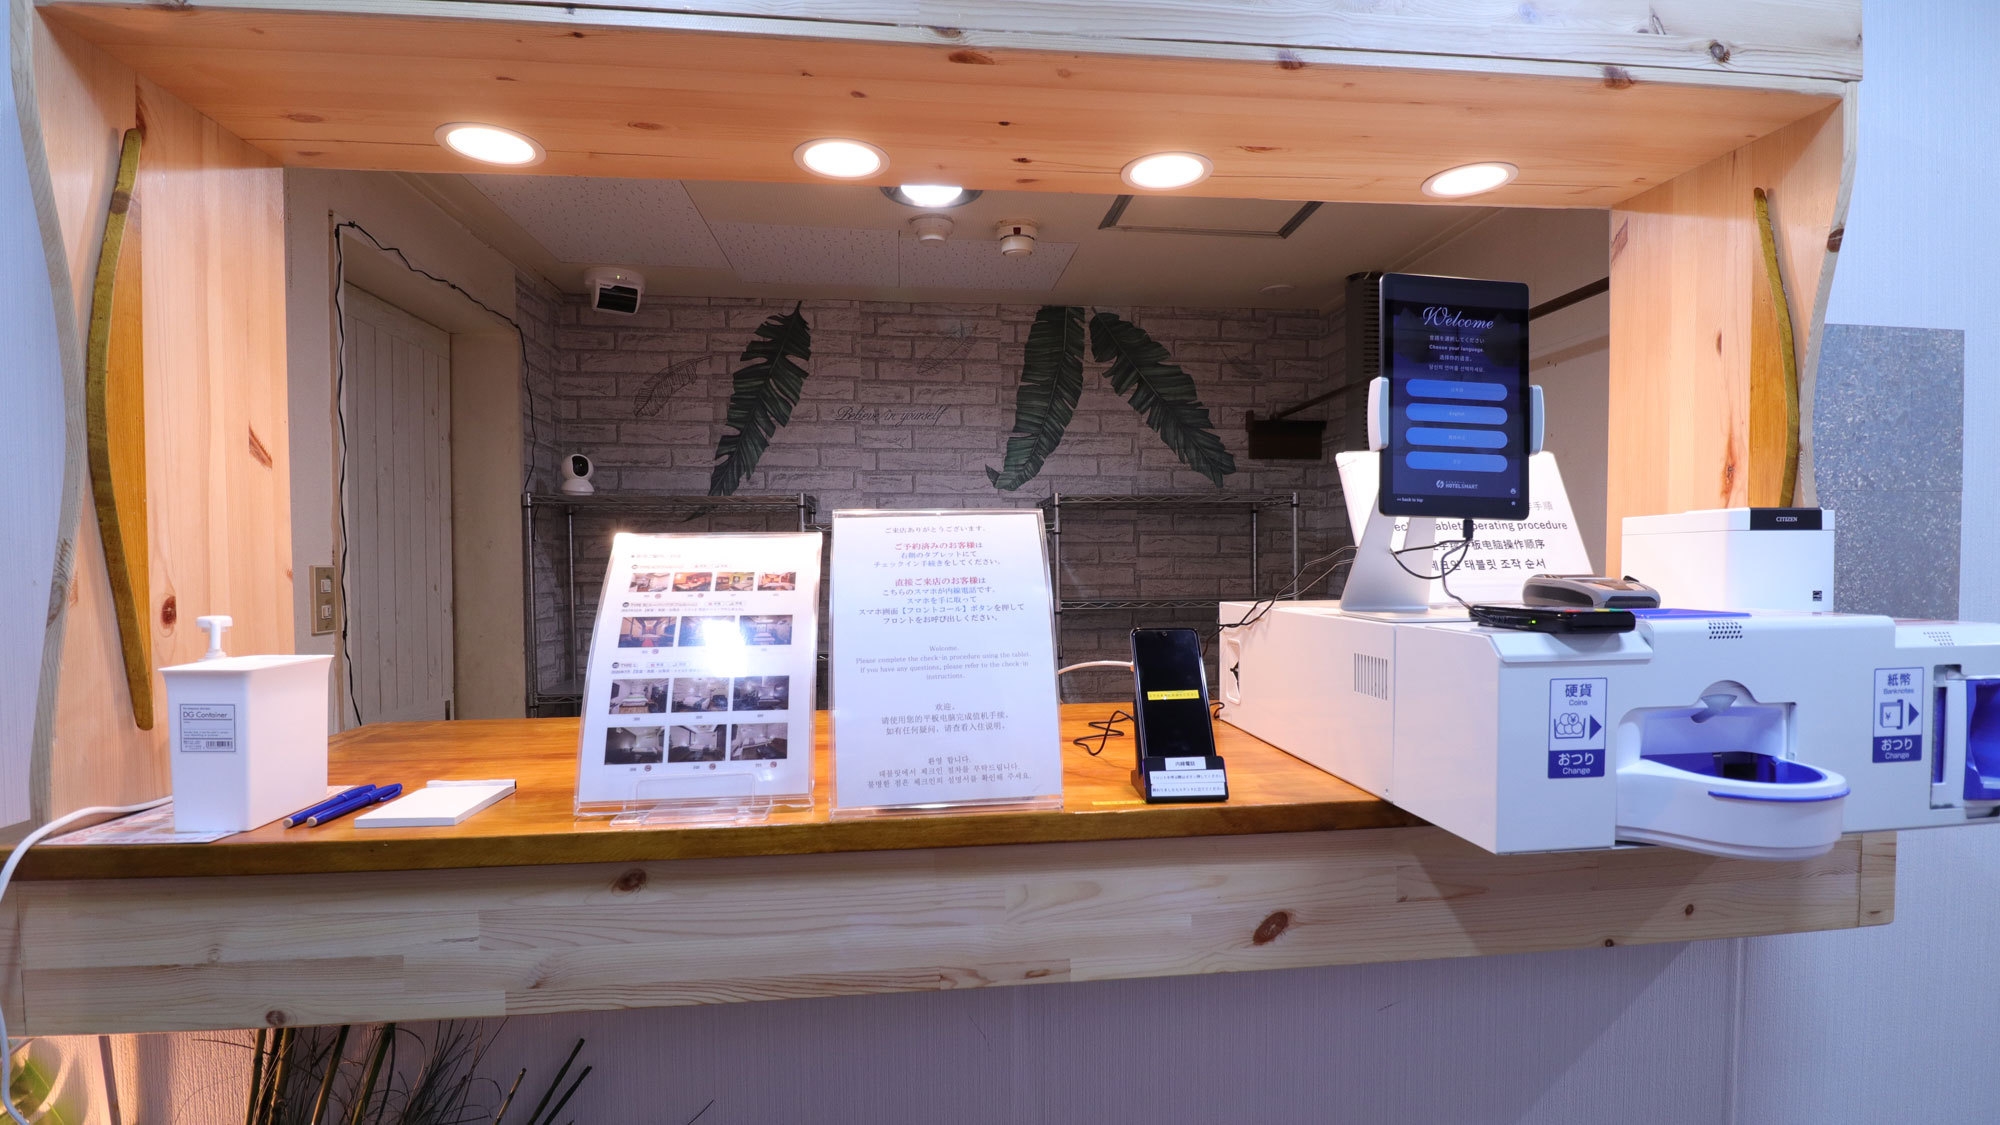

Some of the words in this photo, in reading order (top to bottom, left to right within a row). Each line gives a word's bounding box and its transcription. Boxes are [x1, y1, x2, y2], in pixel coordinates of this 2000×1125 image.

[1422, 306, 1495, 330] Welcome
[834, 404, 879, 421] Believe
[885, 409, 896, 421] in
[895, 403, 952, 428] yourself
[1435, 521, 1463, 531] ablet
[1473, 520, 1514, 532] perating
[1517, 520, 1568, 532] procedure
[895, 541, 983, 551] ご予約済みのお客様は
[1464, 559, 1497, 571] 태블릿
[1501, 558, 1522, 569] 조작
[1524, 558, 1546, 569] 순서
[895, 575, 986, 587] 直接ご来店のお客様は
[855, 657, 876, 665] Please
[877, 656, 906, 665] complete
[907, 655, 919, 663] the
[919, 653, 948, 662] check-in
[949, 653, 981, 662] procedure
[982, 652, 999, 660] using
[999, 651, 1011, 659] the
[866, 667, 879, 675] you
[880, 665, 895, 673] have
[896, 665, 908, 673] any
[909, 663, 942, 672] questions,
[943, 662, 963, 671] please
[964, 661, 980, 669] refer
[1001, 660, 1029, 669] check-in
[926, 672, 965, 681] instructions.
[1887, 672, 1912, 687] 紙幣
[1564, 683, 1592, 698] 硬貨
[195, 711, 228, 719] Container
[1881, 737, 1913, 751] おつり
[1558, 752, 1594, 766] おつり
[1884, 752, 1910, 760] Change
[1562, 767, 1591, 775] Change
